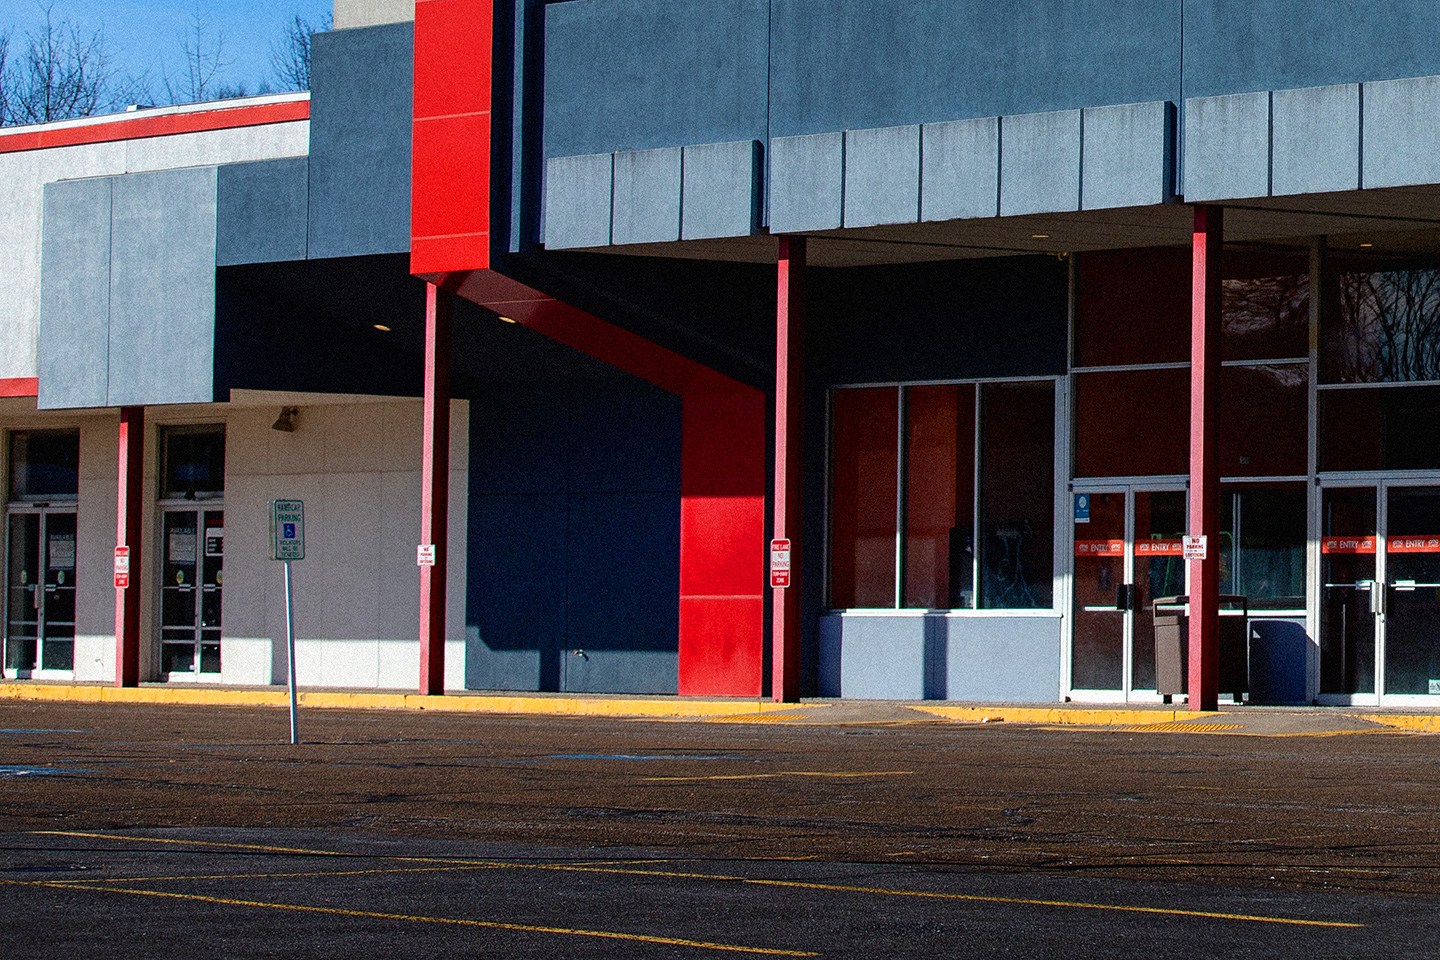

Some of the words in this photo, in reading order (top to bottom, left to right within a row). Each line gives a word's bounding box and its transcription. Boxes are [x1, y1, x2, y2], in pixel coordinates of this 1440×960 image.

[277, 514, 301, 522] PARKING
[1090, 544, 1109, 552] ENTRY
[1151, 543, 1170, 551] ENTRY
[1340, 541, 1358, 549] ENTRY
[1405, 540, 1425, 548] ENTRY
